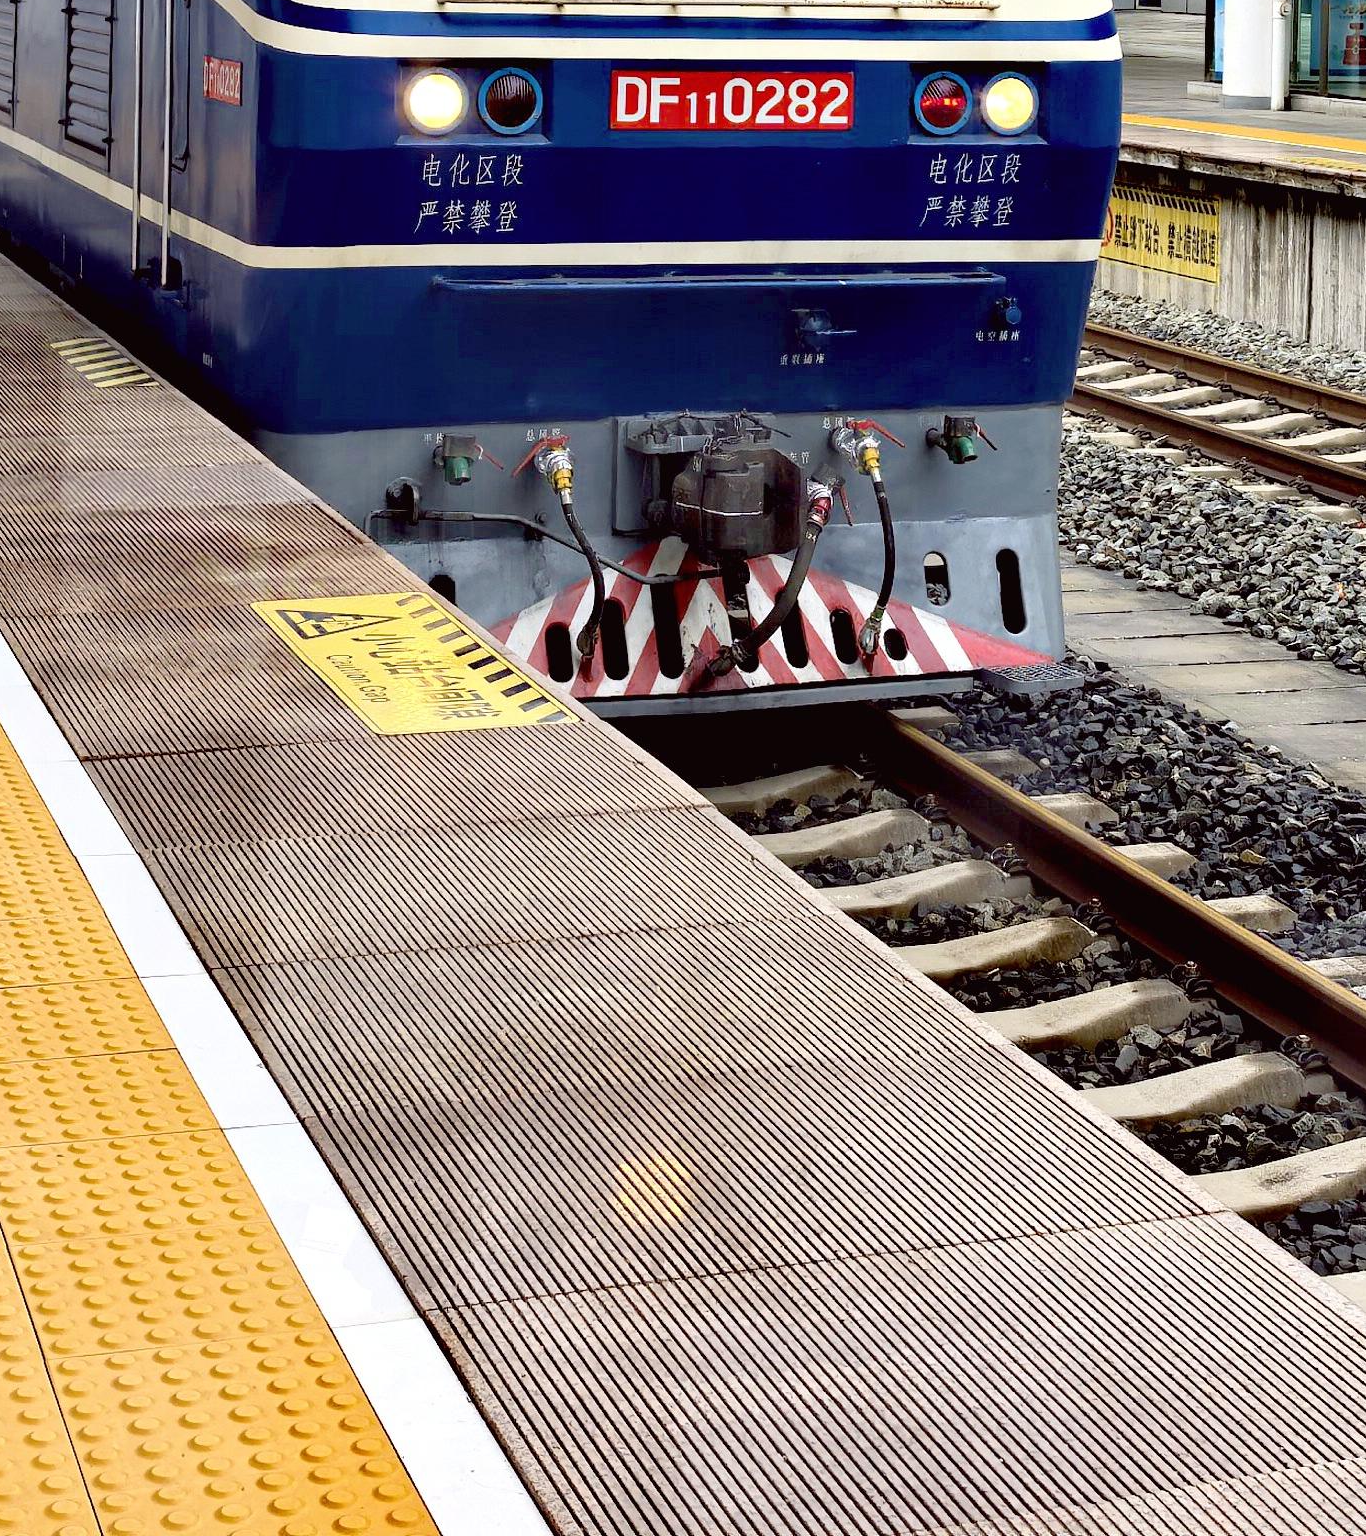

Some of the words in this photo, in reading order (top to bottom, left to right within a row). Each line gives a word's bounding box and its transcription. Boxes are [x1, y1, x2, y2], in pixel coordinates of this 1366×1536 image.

[616, 76, 849, 124] DF110282
[422, 153, 524, 188] 电化区段
[929, 152, 1021, 184] 电化区段
[413, 199, 518, 235] 严禁攀登
[919, 194, 1014, 228] 严禁攀登
[351, 628, 504, 721] 小心站台间隙
